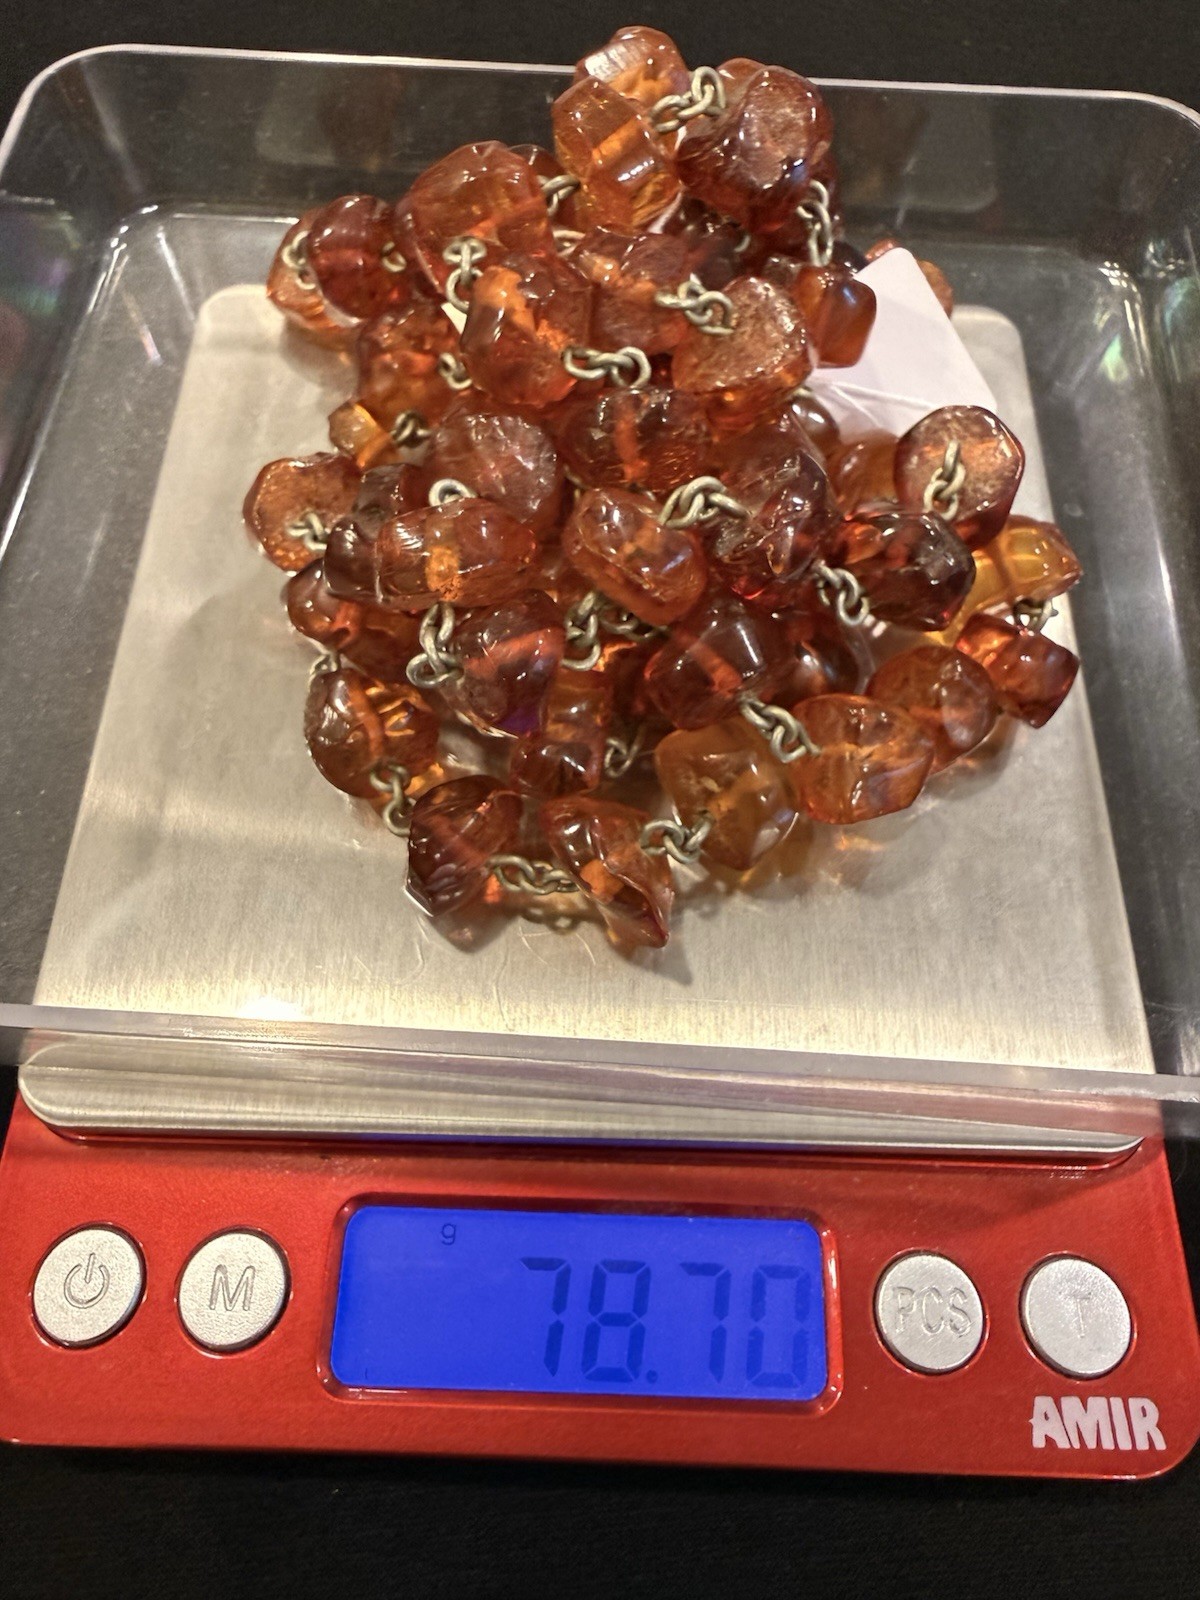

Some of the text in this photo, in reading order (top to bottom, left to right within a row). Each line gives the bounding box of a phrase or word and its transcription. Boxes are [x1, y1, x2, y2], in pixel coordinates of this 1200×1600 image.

[440, 1222, 458, 1246] g
[209, 1264, 256, 1311] M
[892, 1285, 973, 1338] PCS
[520, 1256, 811, 1389] 78.70
[1058, 1290, 1093, 1338] T
[1028, 1395, 1167, 1451] AMIR
